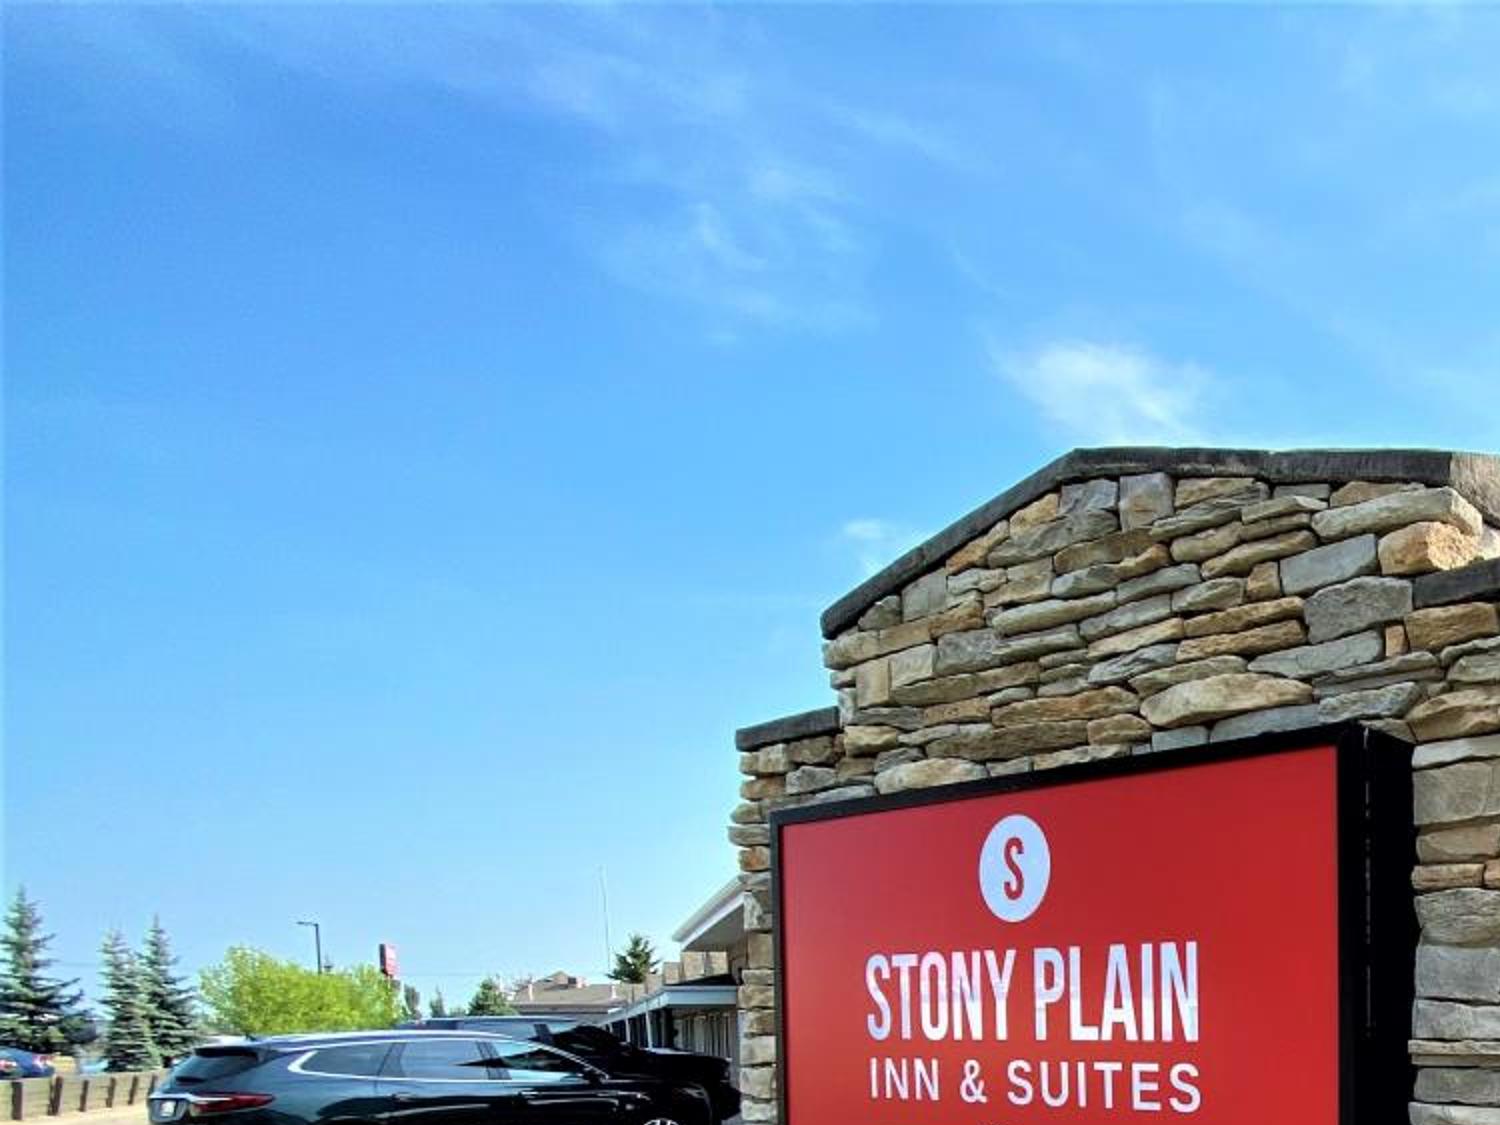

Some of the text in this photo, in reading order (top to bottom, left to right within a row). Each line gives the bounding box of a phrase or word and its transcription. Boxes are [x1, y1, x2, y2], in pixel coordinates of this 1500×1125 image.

[1003, 836, 1025, 901] S
[865, 940, 1199, 1043] STONY PLAIN
[869, 1056, 1201, 1113] INN & SUITES
